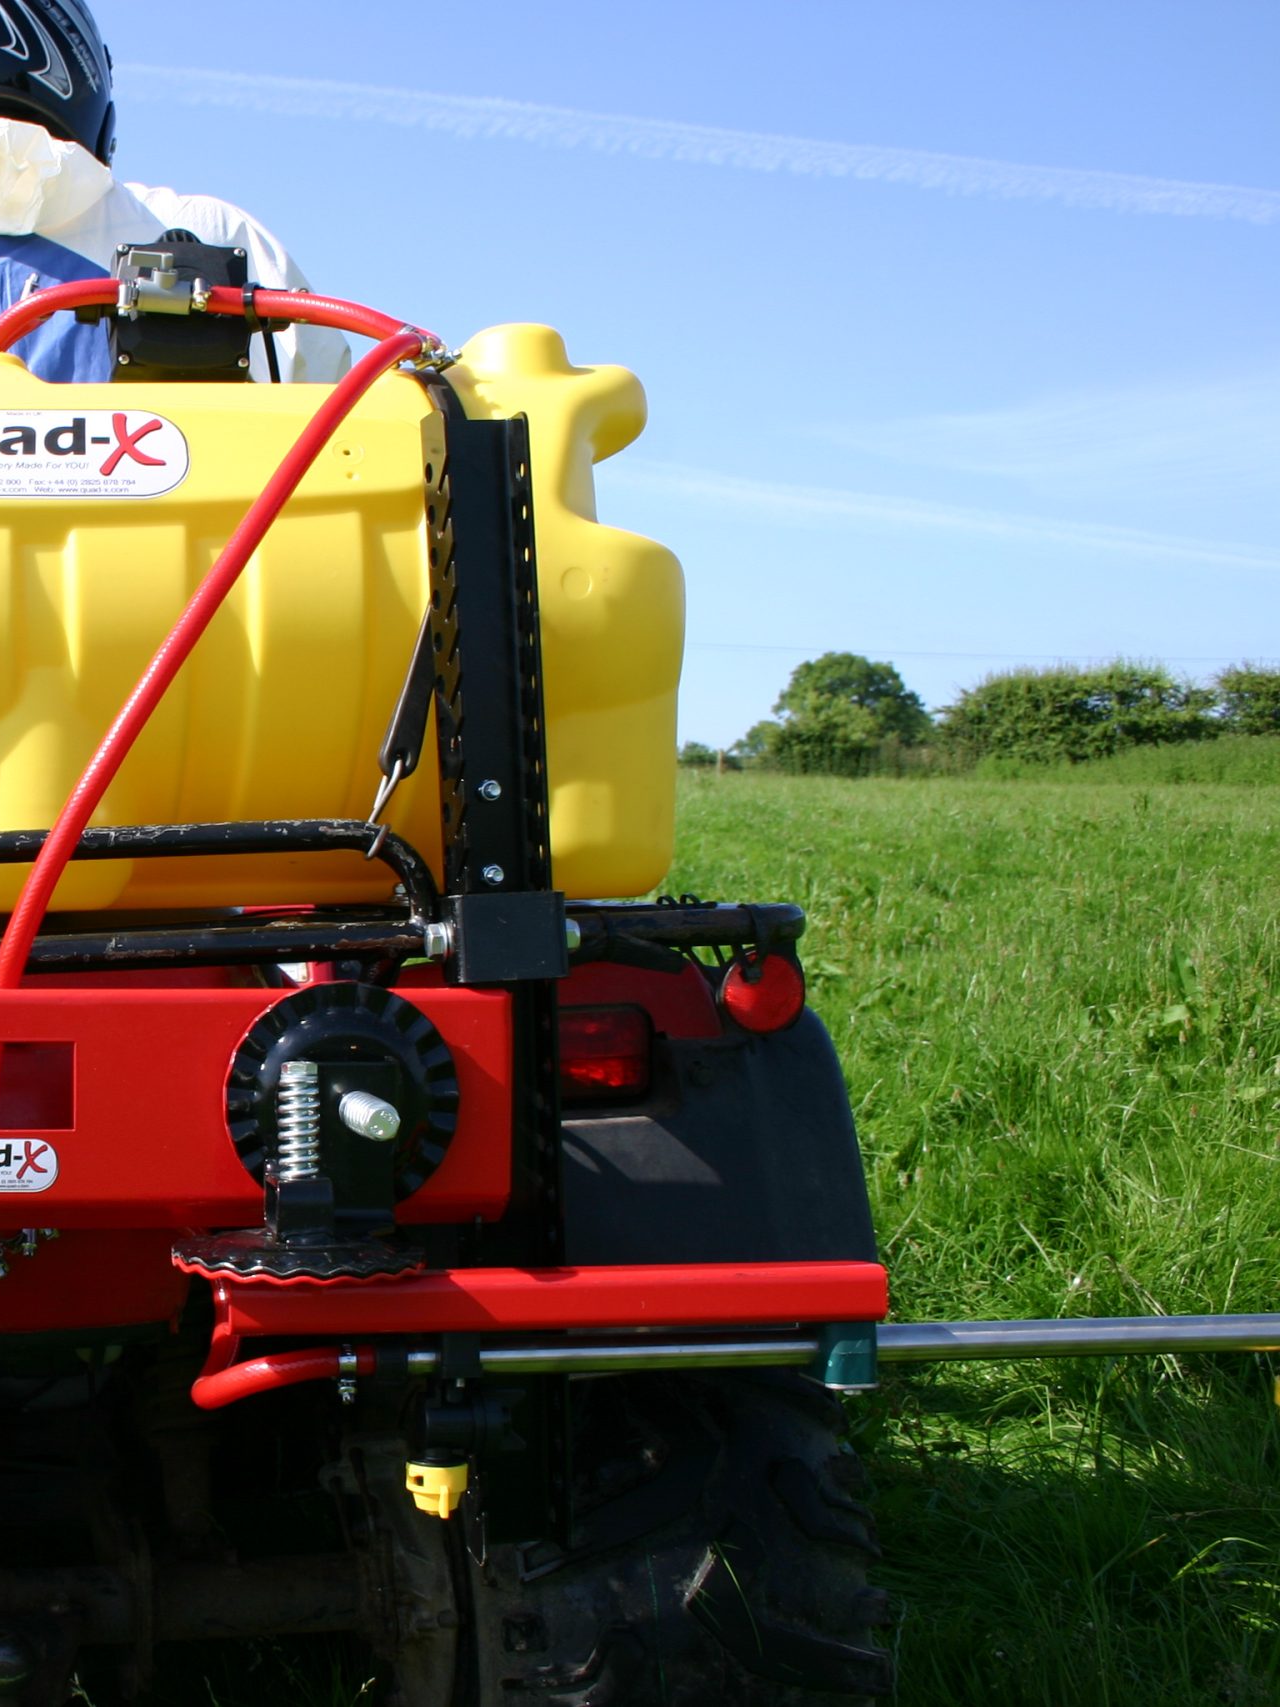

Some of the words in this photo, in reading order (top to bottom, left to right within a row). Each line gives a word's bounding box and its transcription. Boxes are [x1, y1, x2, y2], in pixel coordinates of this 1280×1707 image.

[15, 461, 43, 470] Made
[45, 461, 62, 470] For
[64, 461, 90, 470] YOU!
